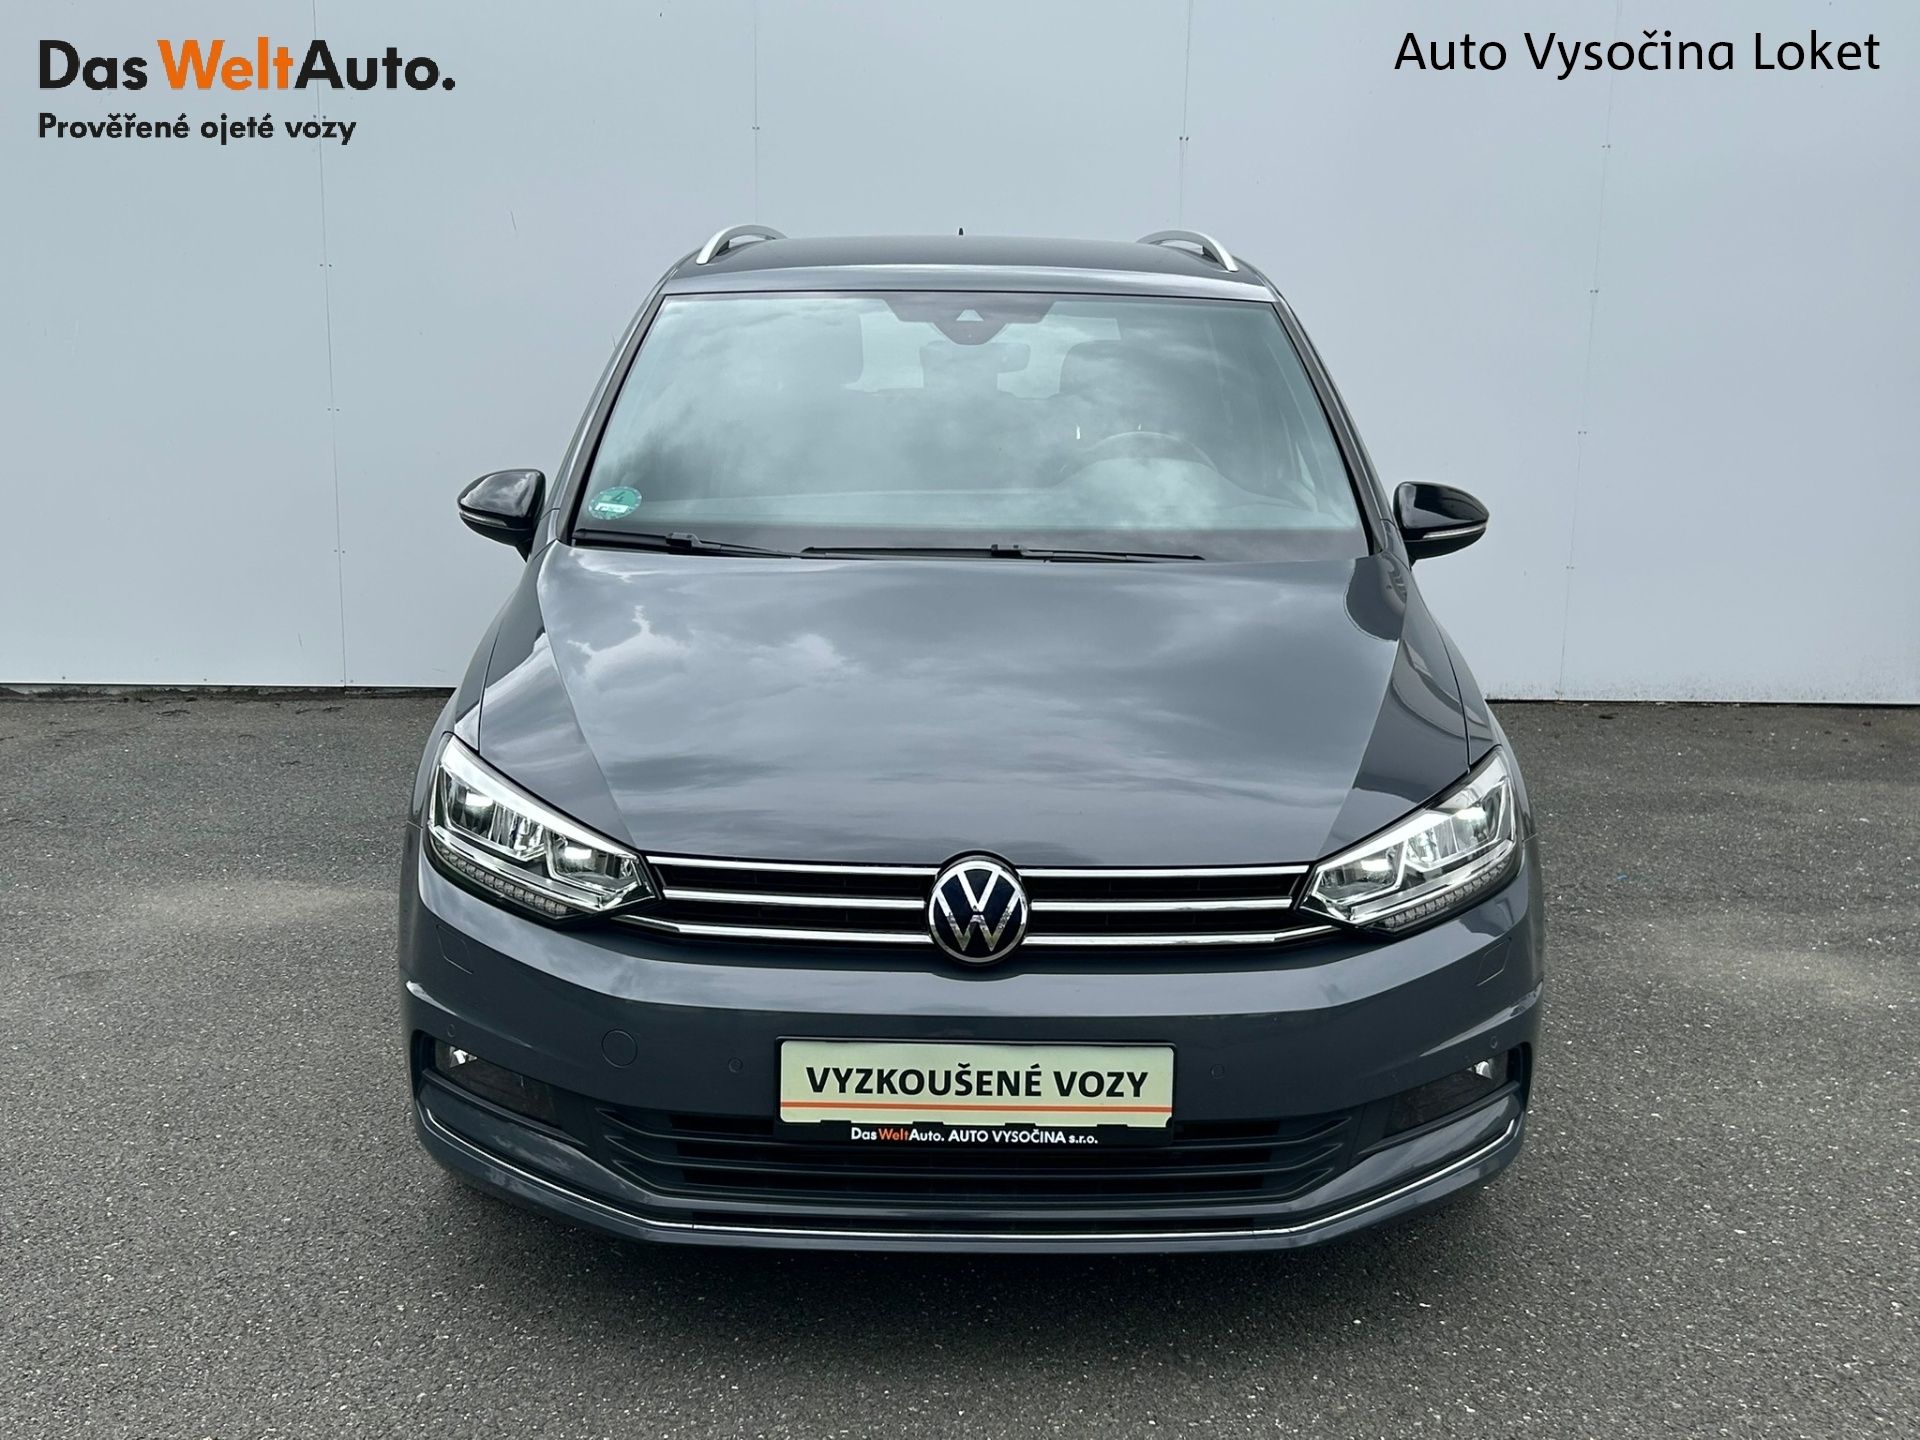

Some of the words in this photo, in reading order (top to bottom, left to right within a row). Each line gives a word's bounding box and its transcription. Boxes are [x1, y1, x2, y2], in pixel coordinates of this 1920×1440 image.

[806, 1062, 1042, 1097] VYZKOUŠENÉ
[1054, 1070, 1149, 1098] VOZY
[948, 1129, 989, 1143] AUTO
[992, 1128, 1067, 1144] VYSOČINA
[1068, 1134, 1099, 1144] s.r.o.
